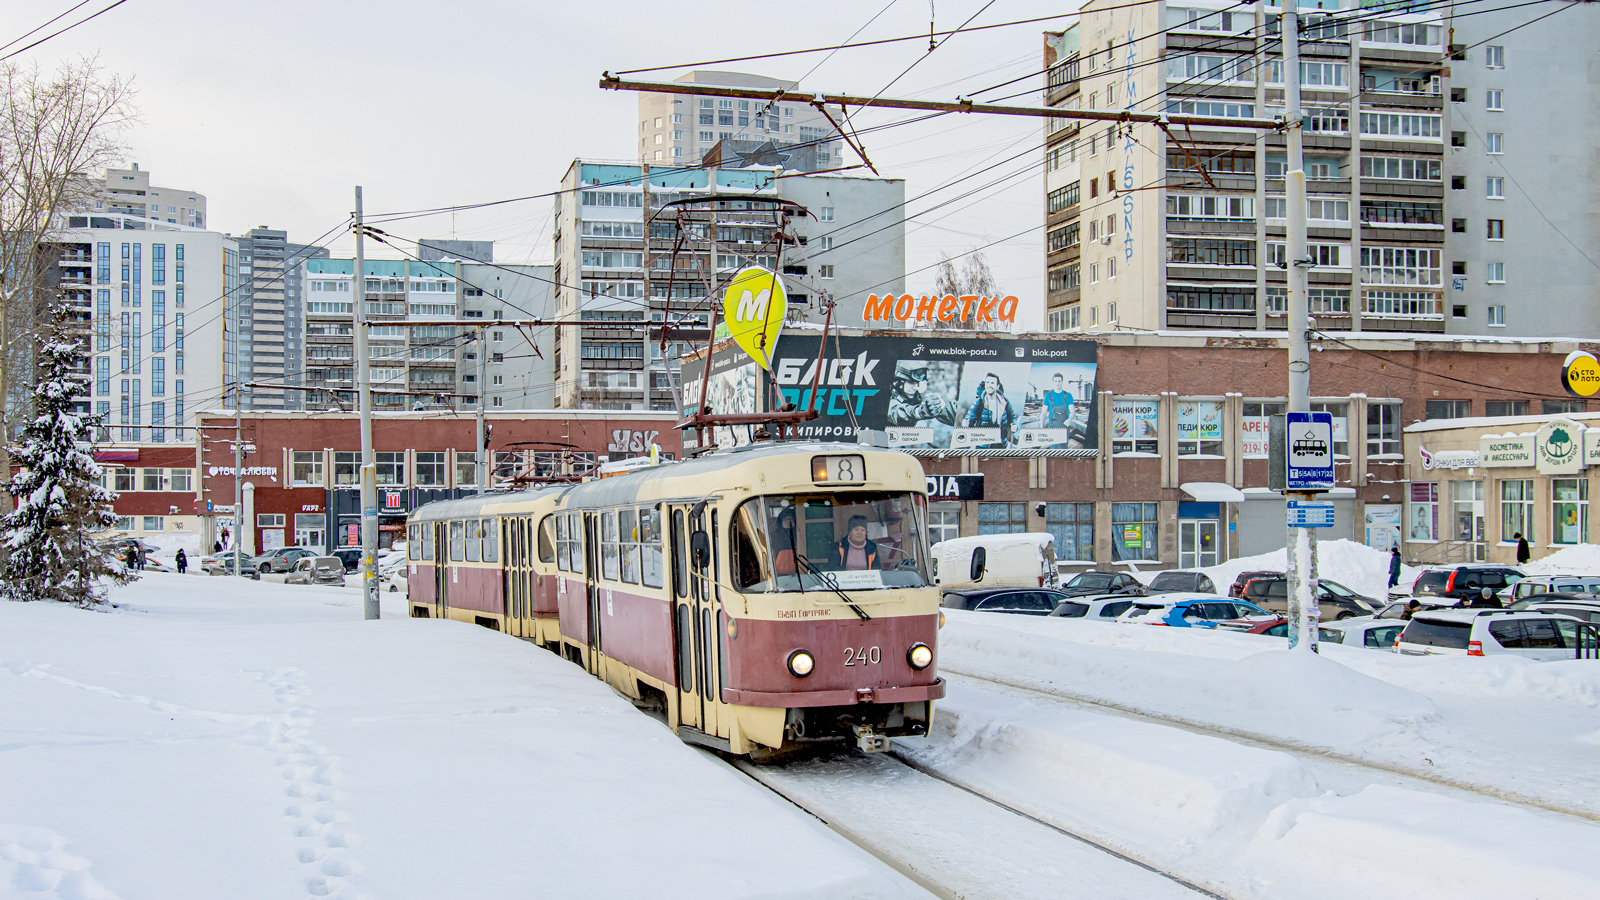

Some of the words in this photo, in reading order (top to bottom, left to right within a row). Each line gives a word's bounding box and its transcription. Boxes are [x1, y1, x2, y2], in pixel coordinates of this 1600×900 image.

[929, 347, 998, 357] www.blok-post.ru
[1032, 347, 1068, 358] blok.post
[776, 350, 880, 386] БЛОК
[1112, 406, 1152, 414] МАНИКЮР
[1178, 423, 1218, 432] ПЕДИКЮР
[1490, 443, 1524, 451] КОСМЕТИКА
[1484, 454, 1489, 462] И
[1491, 453, 1529, 462] АКСЕССУАРЫ
[218, 466, 248, 476] ТОЧА
[838, 458, 854, 481] 8
[843, 645, 882, 667] 240
